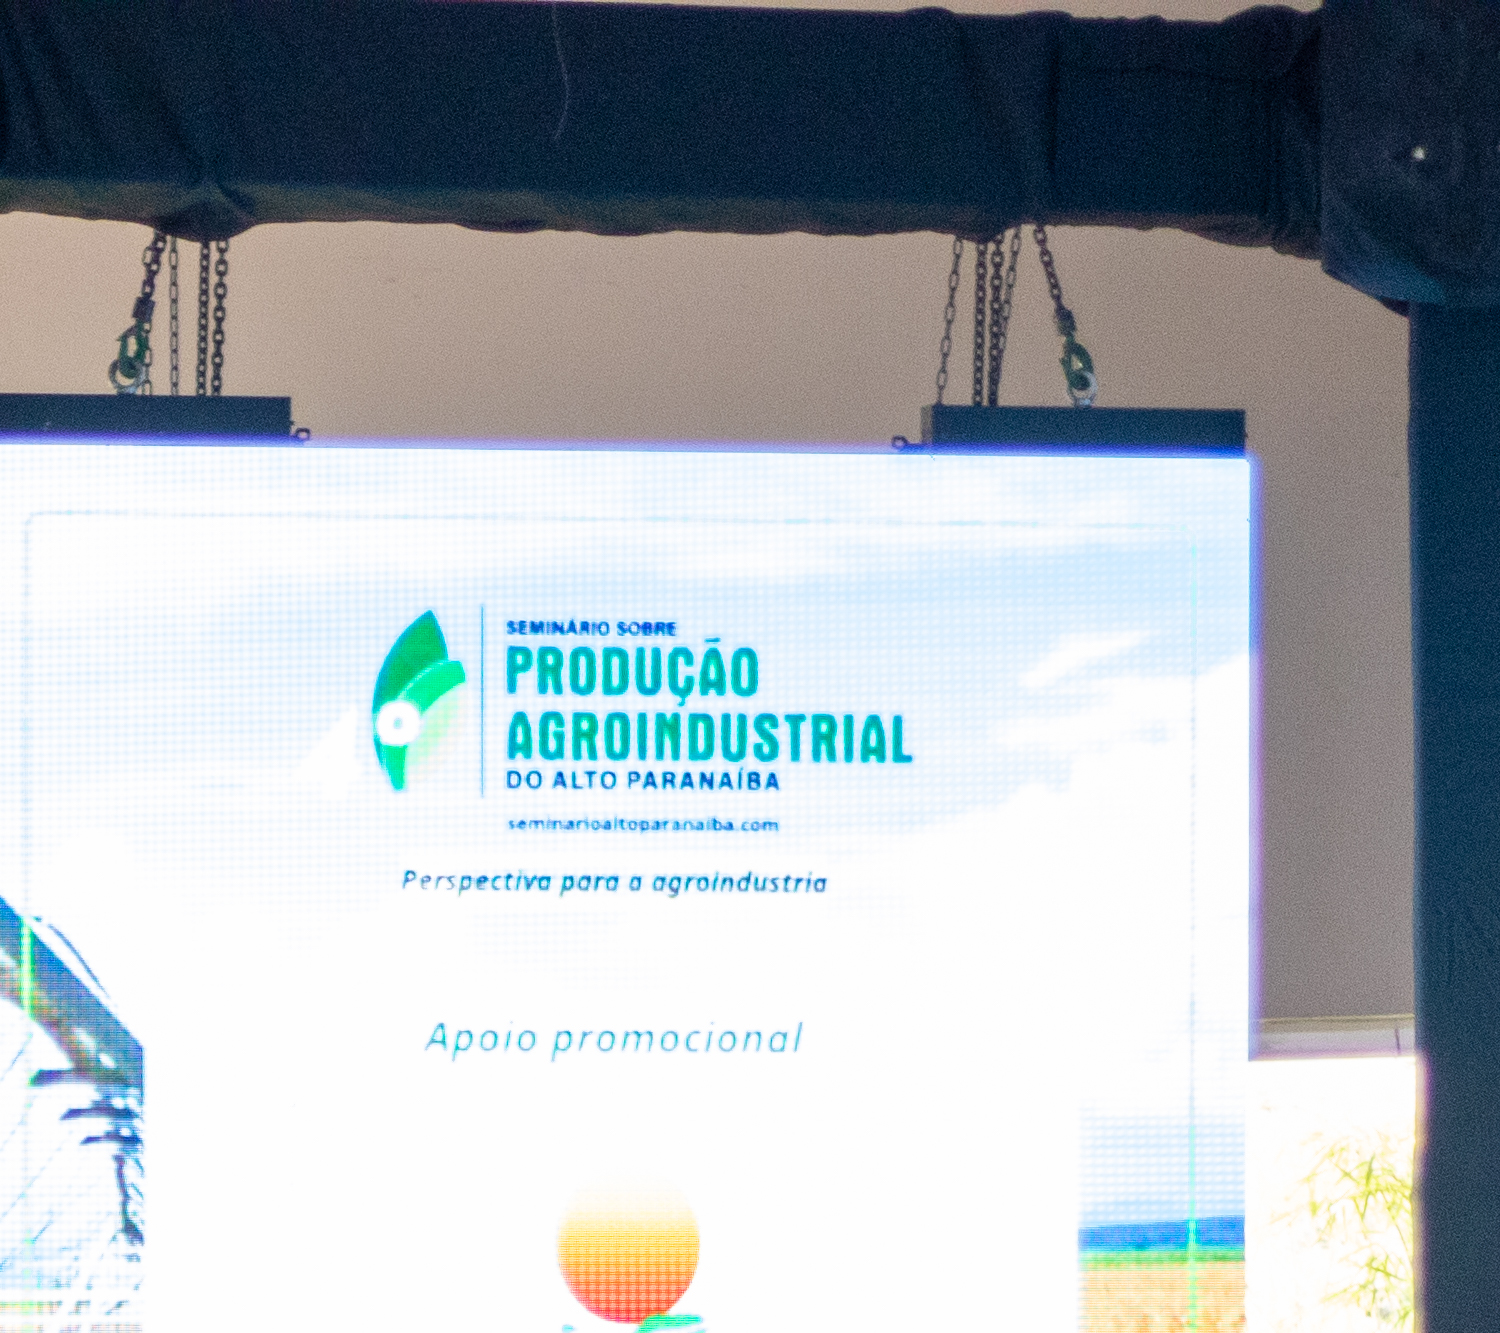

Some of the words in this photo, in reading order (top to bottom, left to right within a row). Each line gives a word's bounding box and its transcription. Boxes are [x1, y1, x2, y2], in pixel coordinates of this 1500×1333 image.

[506, 619, 610, 636] SEMINÁRIO
[617, 621, 676, 636] SOBRE
[506, 637, 759, 706] PRODUÇÃO
[507, 711, 913, 763] AGROINDUSTRIAL
[506, 770, 542, 790] DO
[553, 770, 617, 790] ALTO
[628, 767, 779, 790] PARANAÍBA
[403, 870, 552, 894] Perspectiva
[560, 875, 619, 895] para
[629, 876, 642, 891] a
[426, 1022, 536, 1060] Apoio
[552, 1022, 803, 1061] promocional
